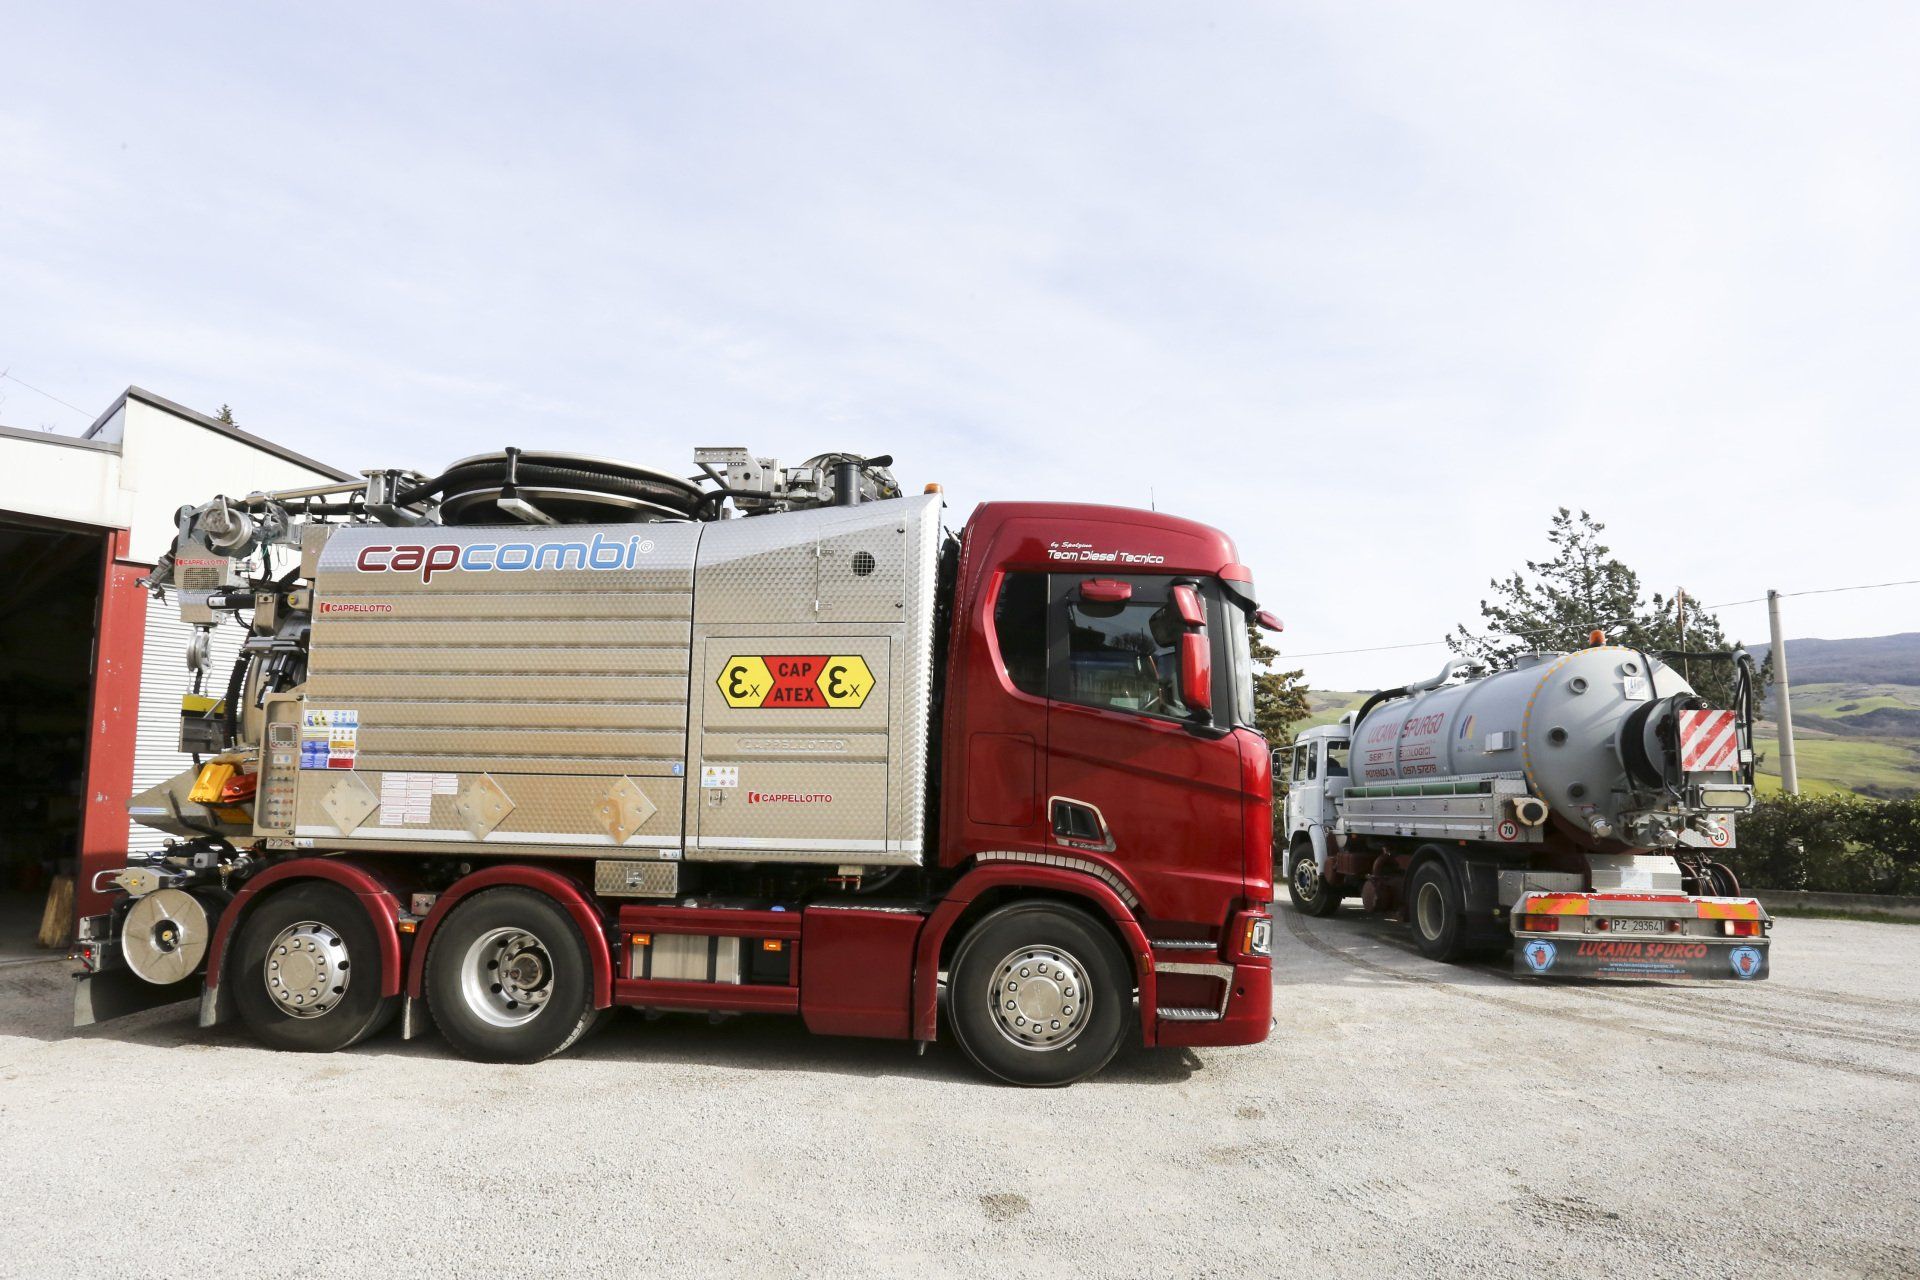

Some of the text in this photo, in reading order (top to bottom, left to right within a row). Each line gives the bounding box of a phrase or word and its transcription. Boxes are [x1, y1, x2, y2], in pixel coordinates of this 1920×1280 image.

[1047, 549, 1164, 564] Team Diesel Tecnico
[331, 604, 392, 612] CAPPELLOTTO
[778, 662, 812, 677] CAP
[773, 687, 814, 702] ATEX
[1402, 712, 1445, 739] SPURGO
[745, 739, 844, 749] CAPPELLOTTO
[1365, 768, 1388, 778] POTENZA
[761, 794, 832, 803] CAPPELLOTTO
[1504, 826, 1513, 835] 70
[1614, 920, 1627, 930] PZ
[1577, 942, 1708, 959] LUCANIA SPURGO
